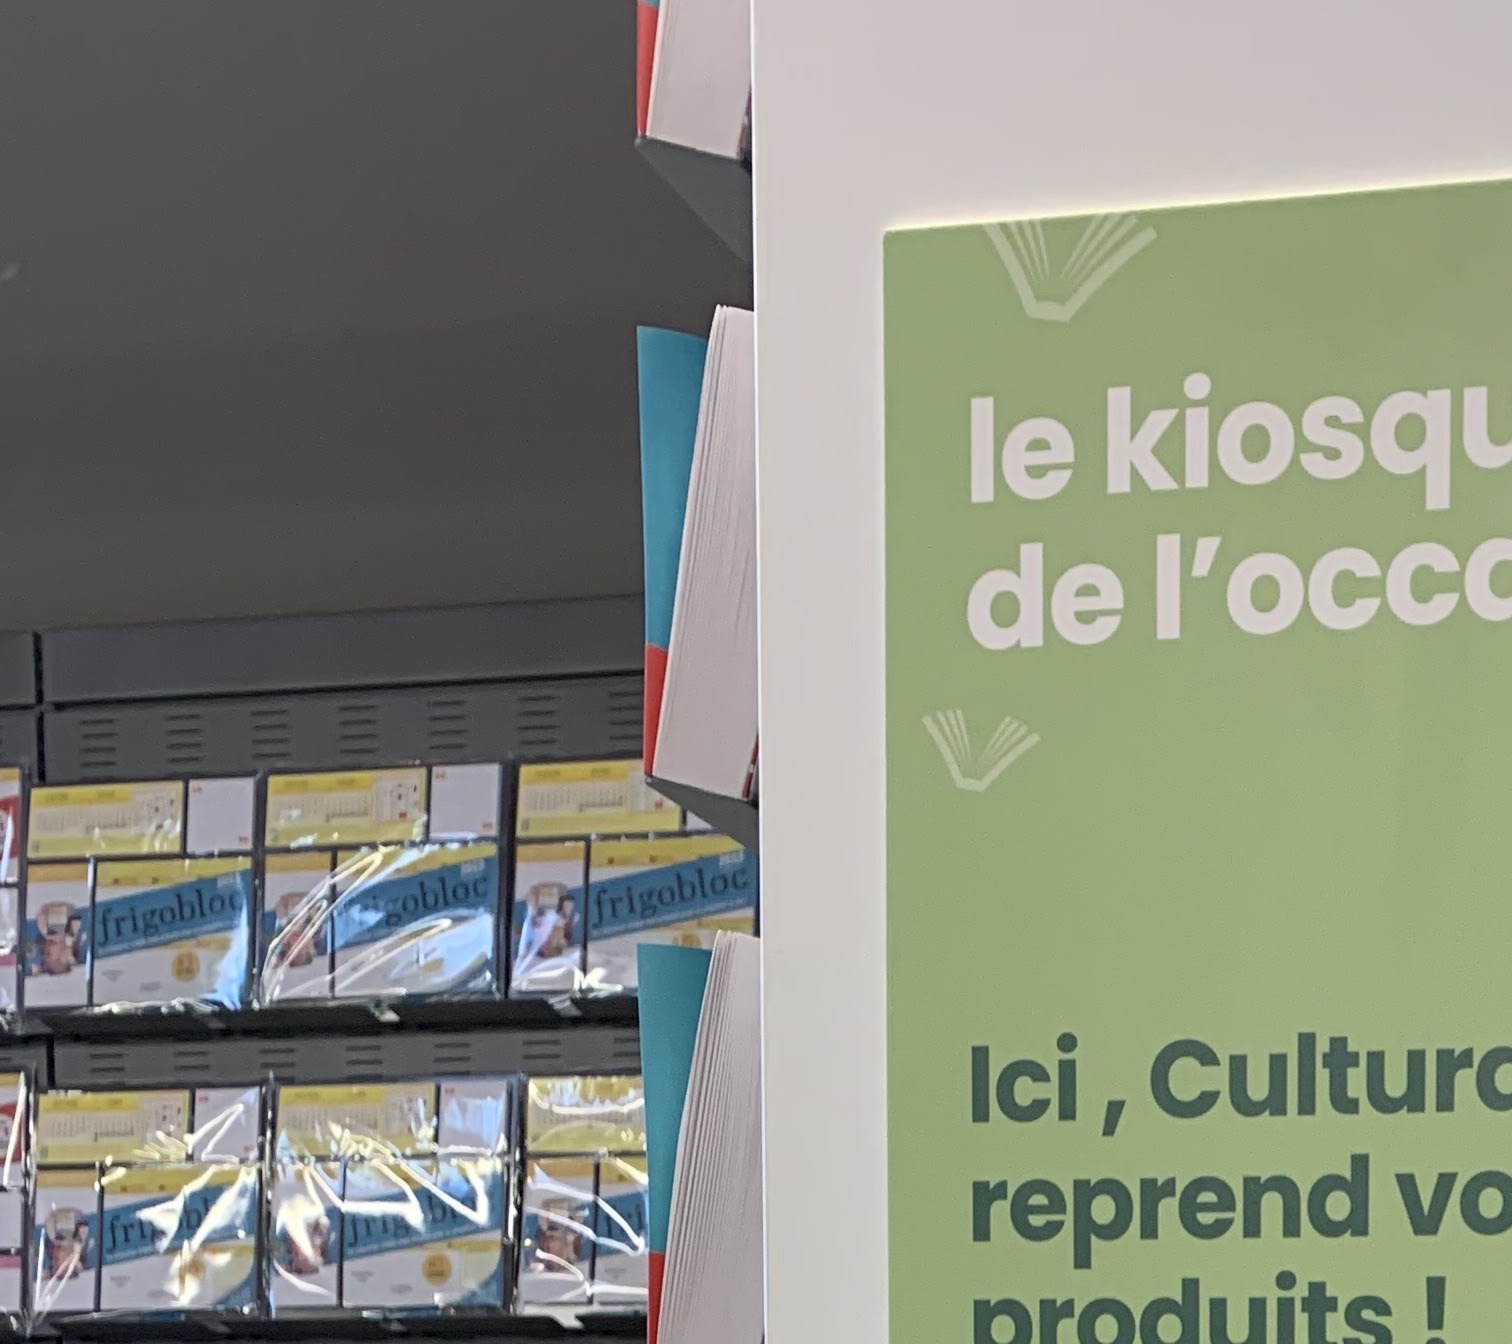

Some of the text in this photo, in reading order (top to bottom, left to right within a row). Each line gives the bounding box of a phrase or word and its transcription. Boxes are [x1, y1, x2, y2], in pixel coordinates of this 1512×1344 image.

[969, 395, 1075, 503] le
[966, 542, 1126, 650] de
[592, 867, 748, 929] frigobloc
[971, 1032, 1078, 1123] Ici
[972, 1153, 1370, 1269] reprend
